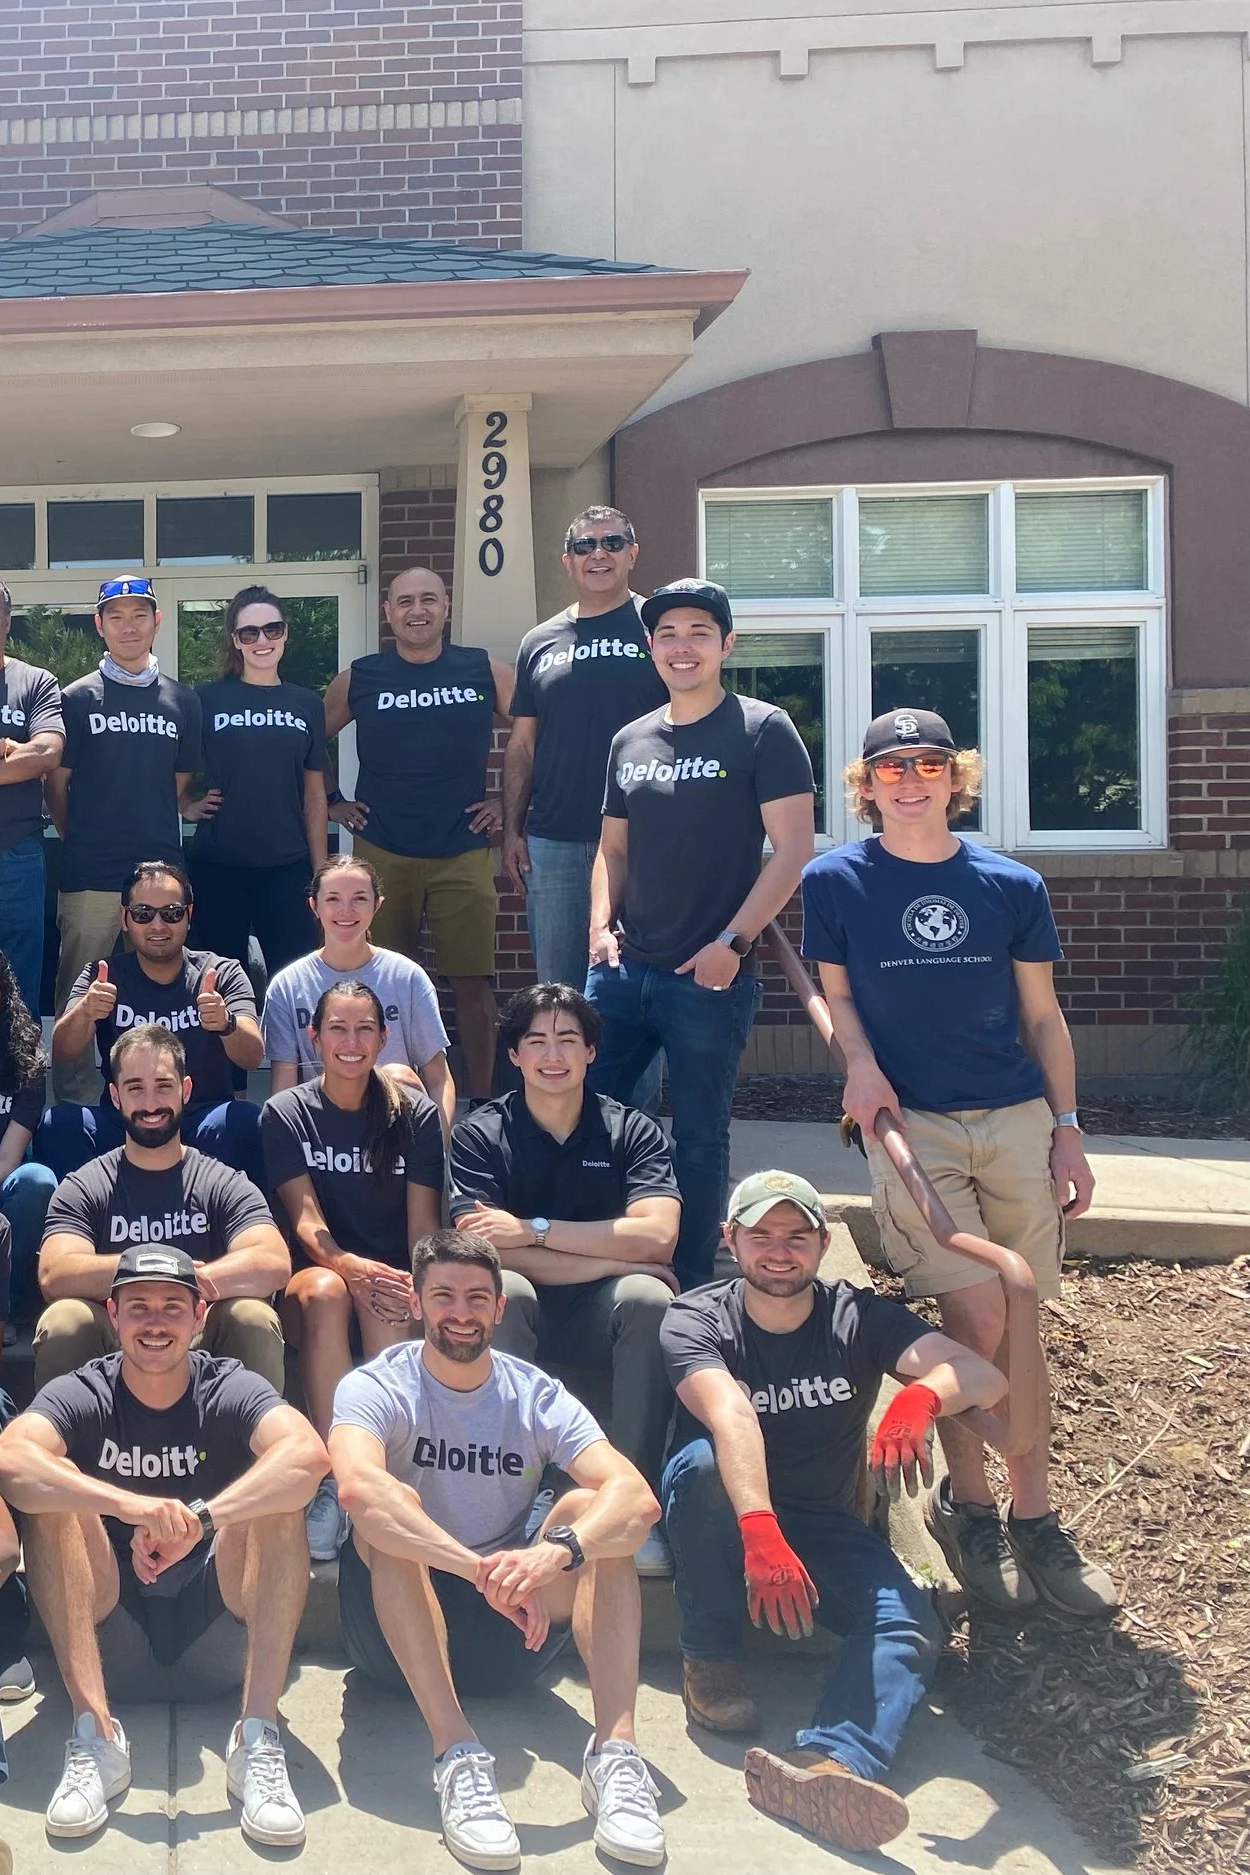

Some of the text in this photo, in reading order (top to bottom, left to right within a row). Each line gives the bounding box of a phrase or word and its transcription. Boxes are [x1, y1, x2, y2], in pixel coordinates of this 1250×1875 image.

[478, 411, 508, 577] 2980
[880, 958, 915, 969] DENVER
[916, 956, 962, 965] LANGUAGE
[115, 1004, 203, 1033] Deloitt
